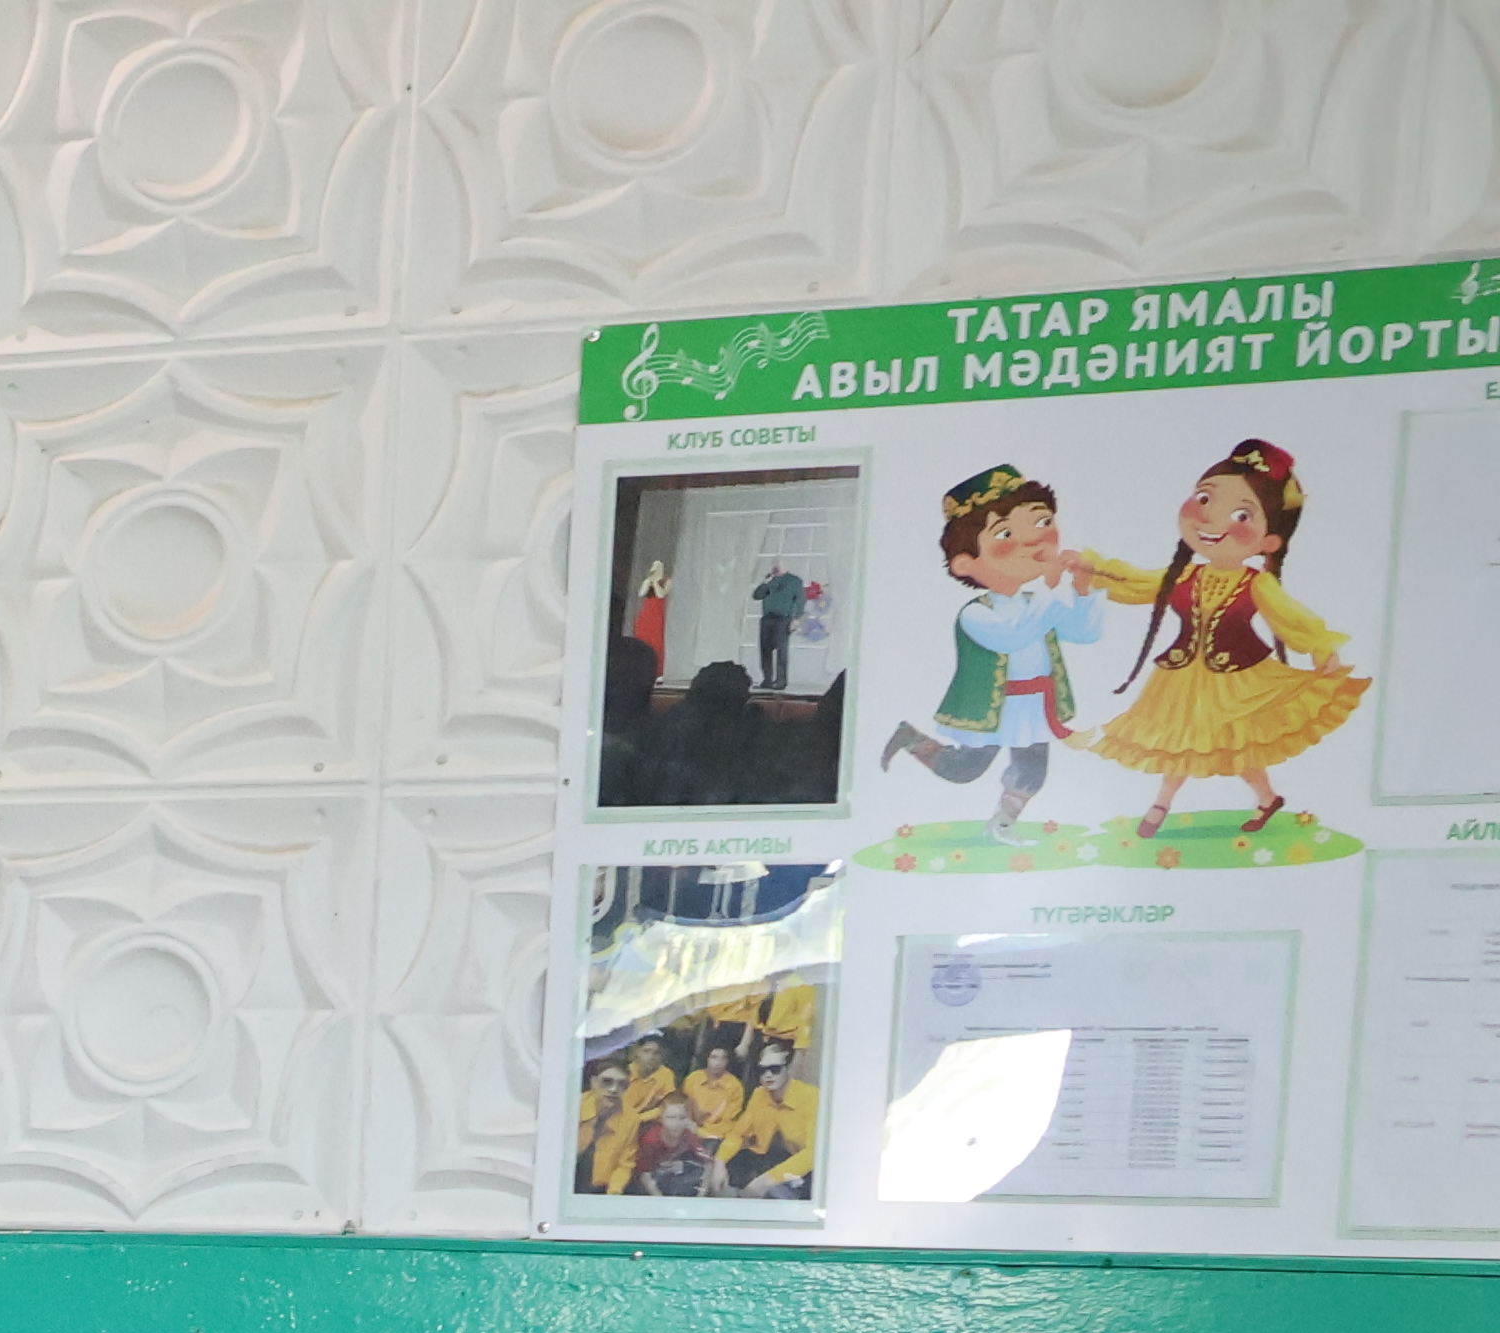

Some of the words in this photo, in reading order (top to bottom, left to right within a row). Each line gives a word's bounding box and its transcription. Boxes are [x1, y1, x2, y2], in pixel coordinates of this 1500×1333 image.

[947, 298, 1109, 344] ТАТАР
[1130, 281, 1335, 332] ЯМАЛЫ
[792, 356, 938, 402] АВЫЛ
[963, 333, 1274, 391] МӘДӘНИЯТ
[1296, 316, 1500, 367] ЙОРТЫ
[668, 431, 724, 450] КЛУБ
[730, 425, 817, 447] СОВЕТЫ
[643, 838, 699, 857] КЛУБ
[704, 836, 793, 855] АКТИВЫ
